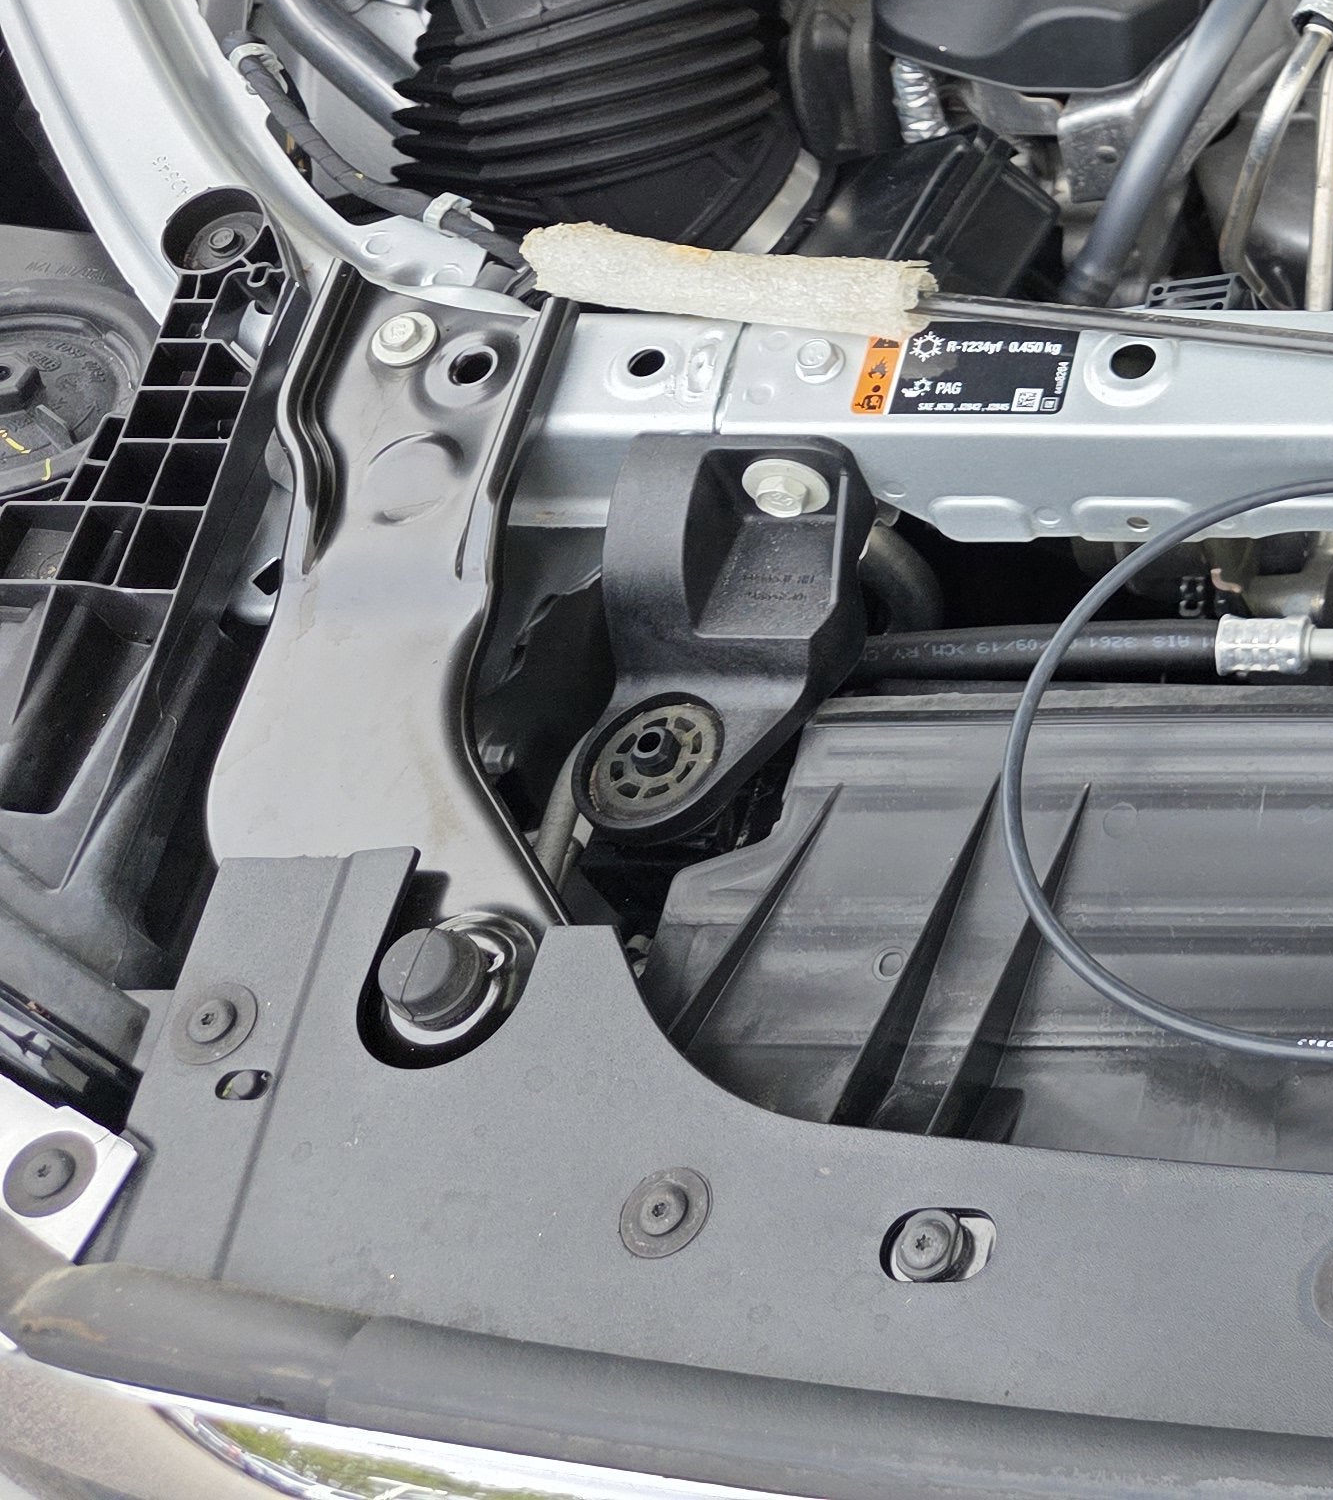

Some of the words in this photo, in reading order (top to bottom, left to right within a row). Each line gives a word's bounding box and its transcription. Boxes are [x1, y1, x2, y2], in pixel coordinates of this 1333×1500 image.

[946, 341, 1004, 354] R-1234yf
[1008, 341, 1044, 353] 0.450
[1044, 342, 1062, 355] kg
[935, 382, 963, 394] PAG
[1089, 636, 1138, 649] 3261
